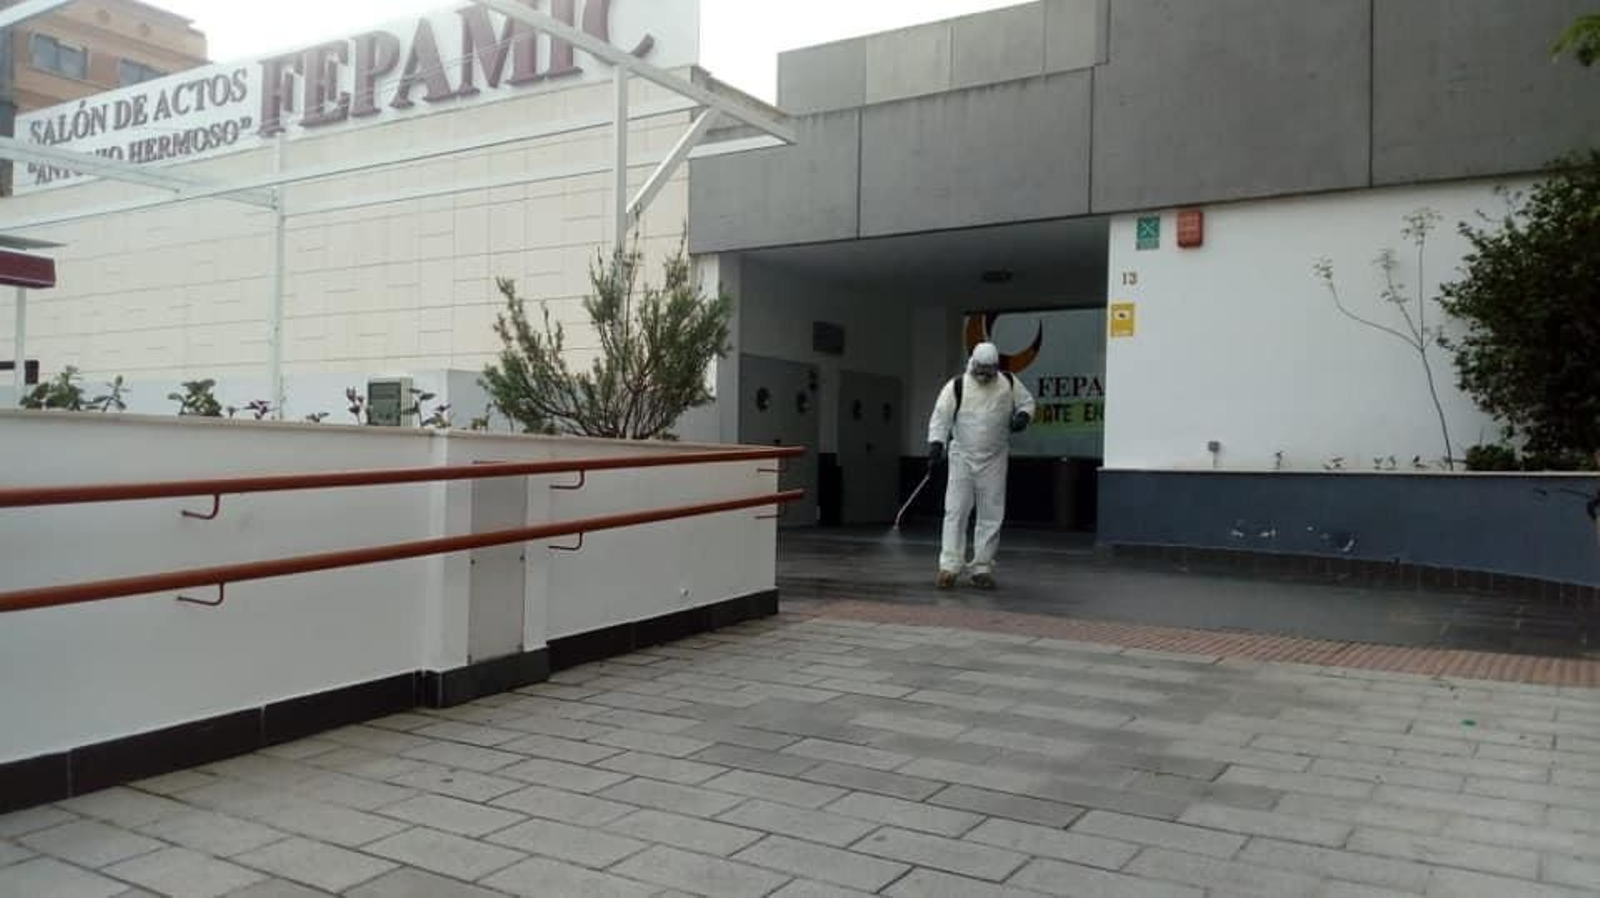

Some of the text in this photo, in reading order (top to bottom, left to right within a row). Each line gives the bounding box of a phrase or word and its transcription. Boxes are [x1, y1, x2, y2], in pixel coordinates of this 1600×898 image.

[29, 68, 248, 146] SALÓN DE ACTOS
[1122, 272, 1138, 286] 13
